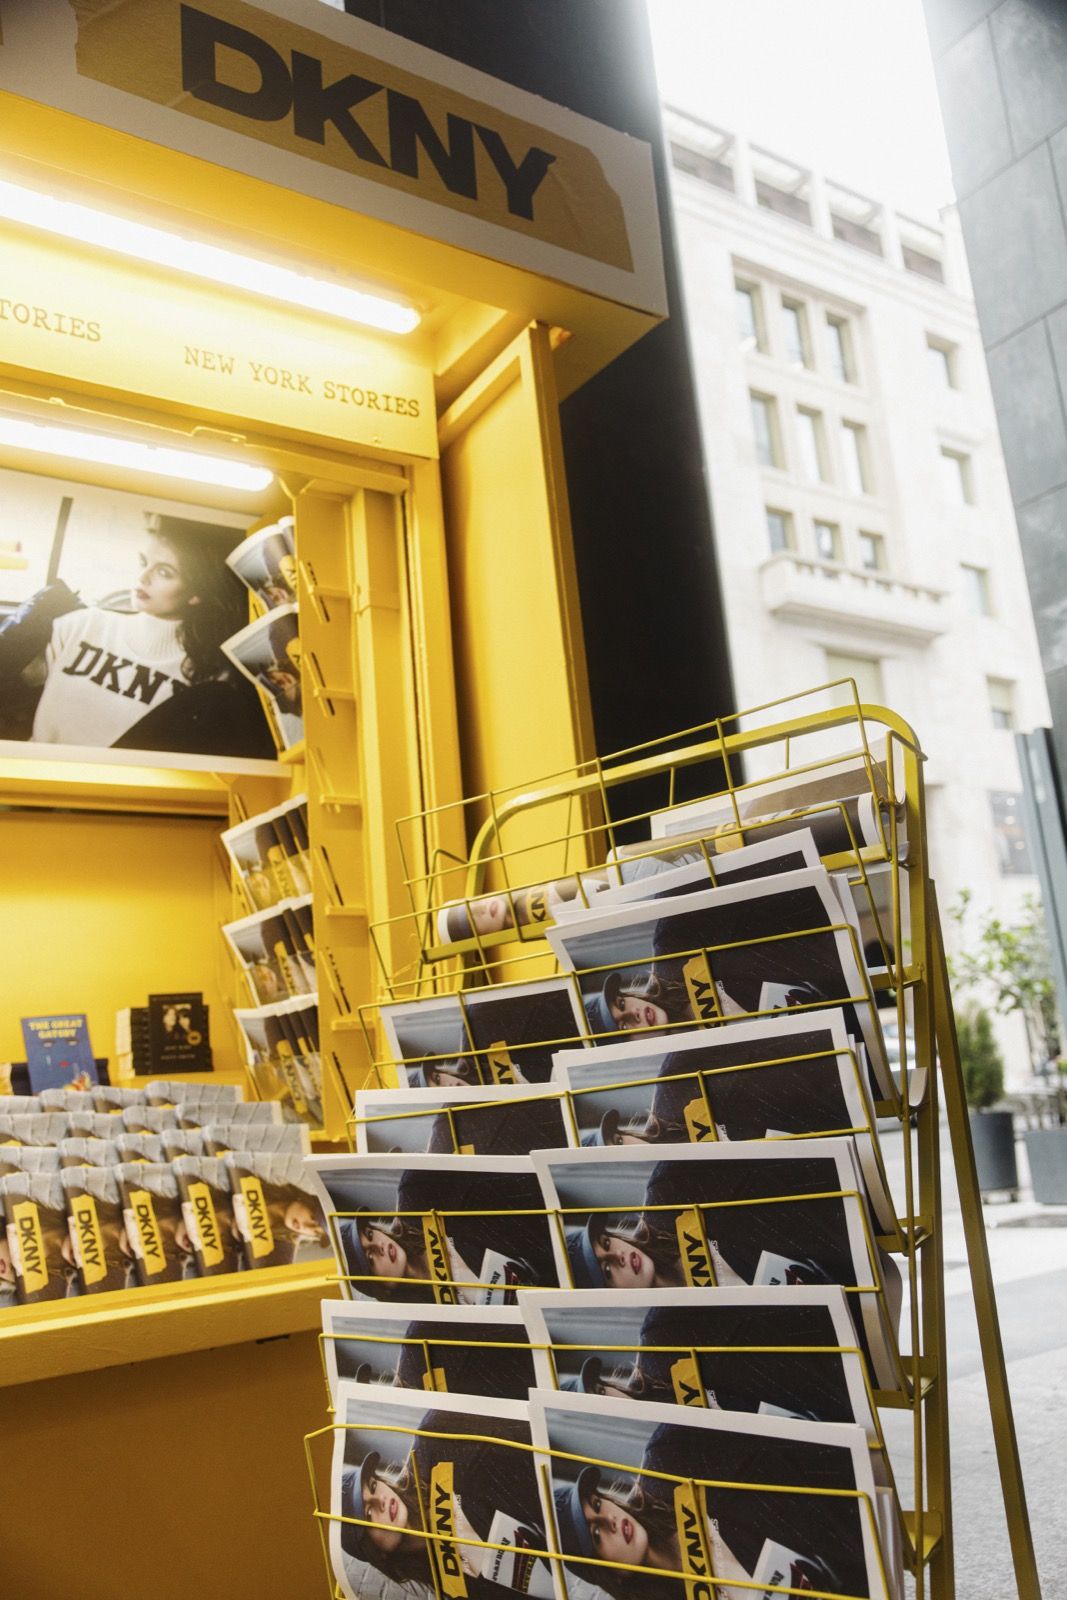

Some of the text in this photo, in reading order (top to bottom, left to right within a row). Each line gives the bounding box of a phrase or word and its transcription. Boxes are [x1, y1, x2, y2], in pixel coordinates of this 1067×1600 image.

[181, 4, 557, 221] DKNY
[184, 346, 420, 417] NEW YORK STORIES
[77, 1210, 101, 1267] DKNY
[136, 1204, 160, 1259] DKNY
[194, 1197, 219, 1251] DKNY
[246, 1190, 268, 1241] DKNY
[19, 1216, 42, 1275] DKNY
[435, 1483, 460, 1577] DKNY
